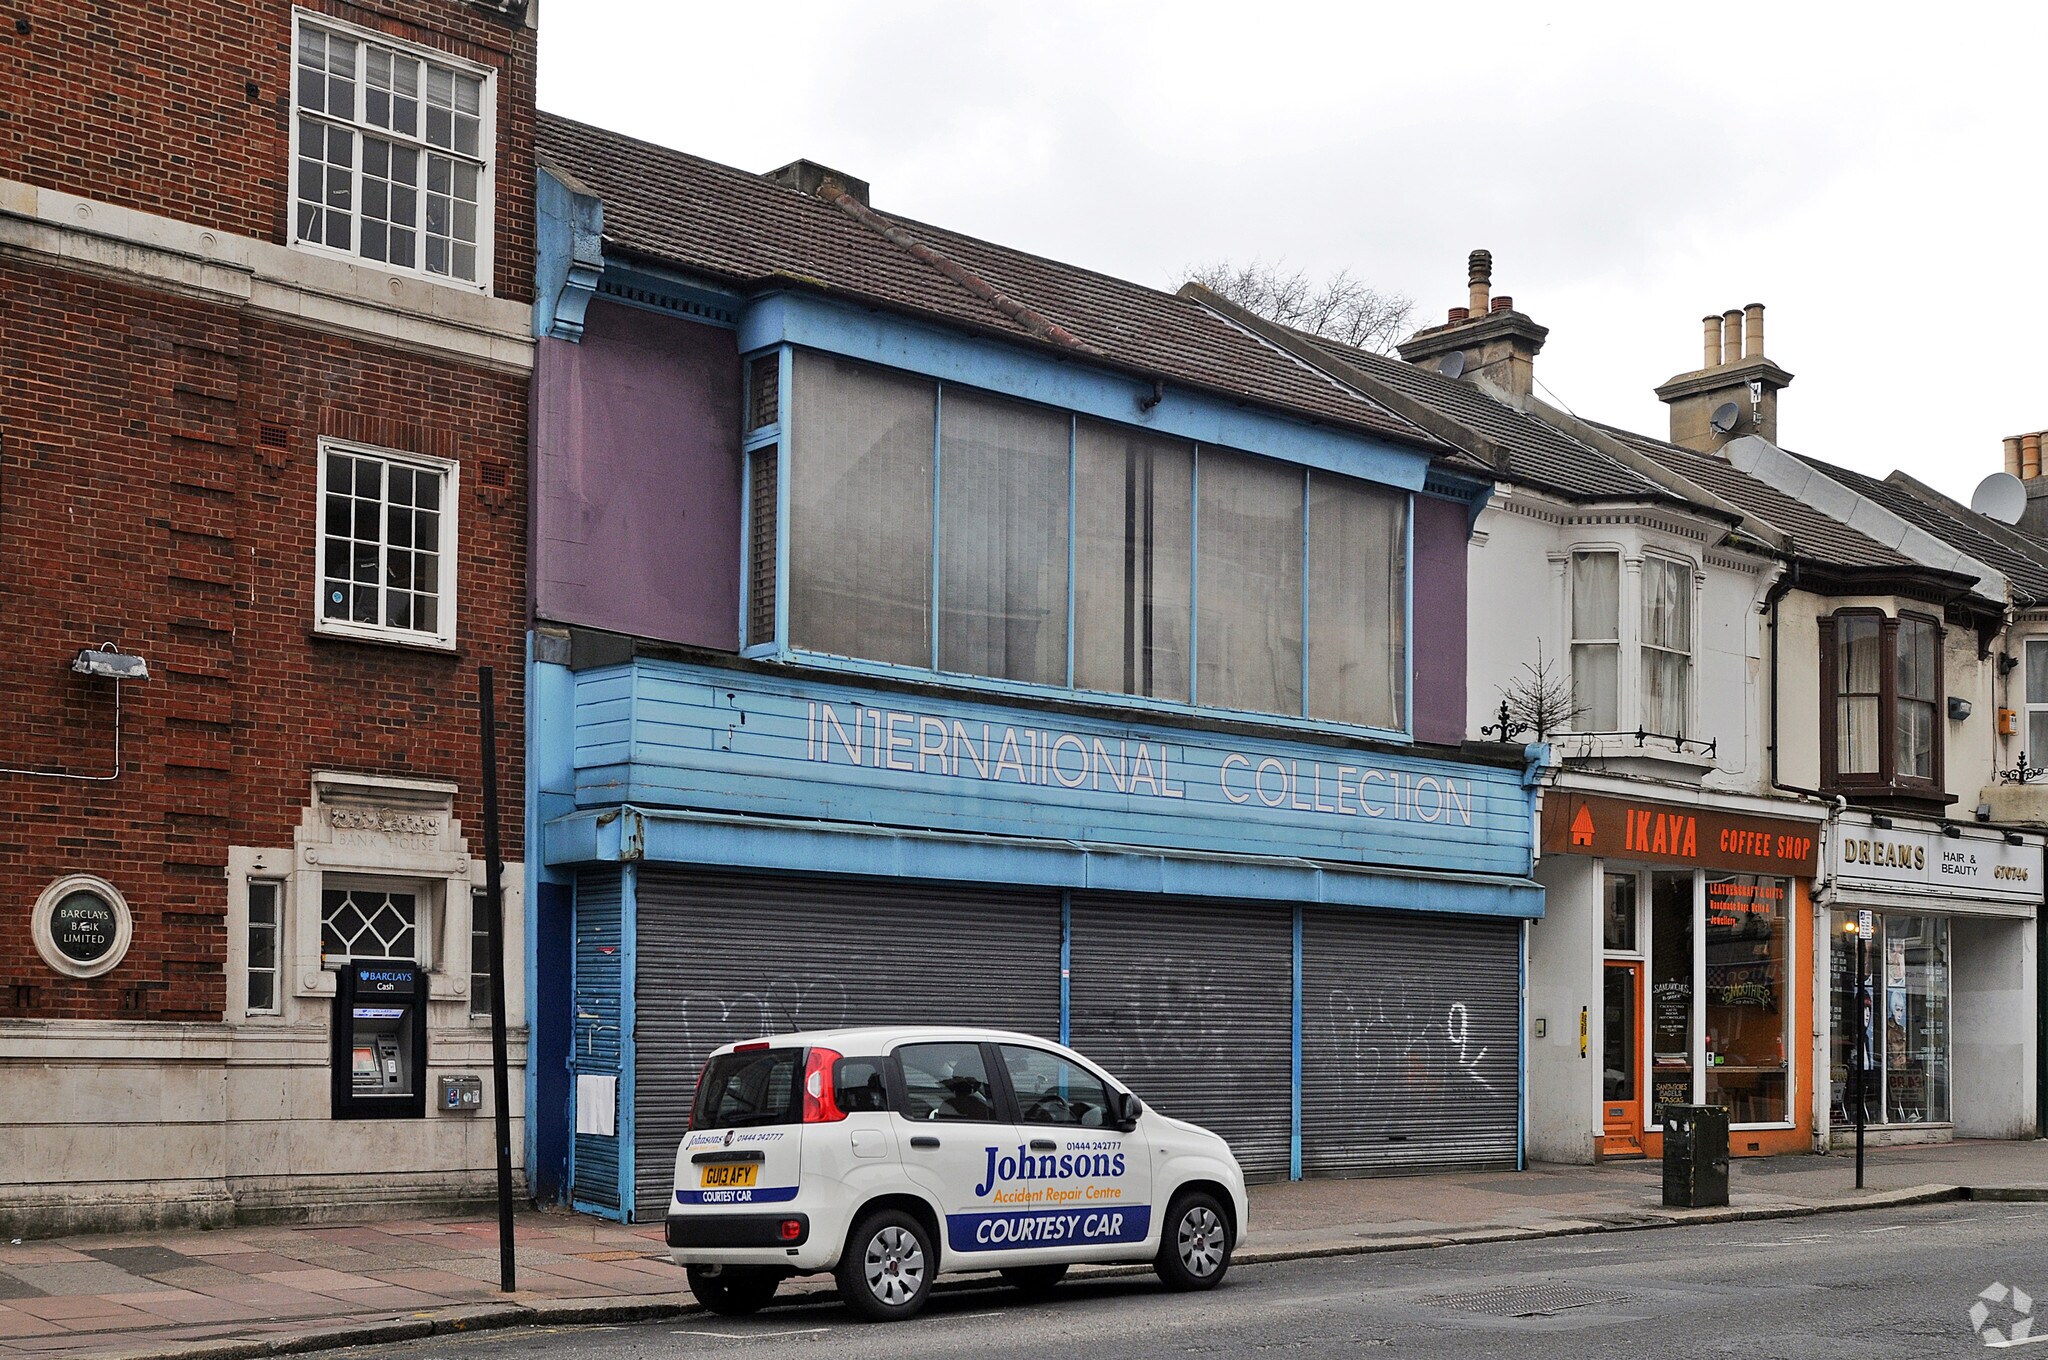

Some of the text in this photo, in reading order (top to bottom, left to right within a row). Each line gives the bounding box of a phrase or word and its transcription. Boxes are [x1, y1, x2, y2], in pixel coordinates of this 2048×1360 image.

[808, 702, 1471, 827] INTERNATIONAL COLLECTION
[339, 833, 434, 851] BANK HOUSE
[1625, 809, 1811, 860] IKAYA COFFEE SHOP
[1844, 838, 1925, 870] DREAMS
[1943, 852, 1976, 863] HAIR &
[1941, 864, 1978, 876] BEAUTY
[1994, 865, 2028, 881] 670746
[1710, 882, 1759, 898] LEATHERCRAFT
[1766, 887, 1784, 900] GIFTS
[60, 910, 108, 920] BARCLAYS
[72, 922, 98, 932] BNK
[64, 934, 104, 944] LIMITED
[370, 972, 412, 981] BARCLAYS
[1723, 982, 1770, 1004] SMOOTHIES
[686, 1134, 723, 1150] Johnsons
[737, 1134, 756, 1142] 01444
[756, 1133, 784, 1141] 242777
[1067, 1141, 1121, 1150] 01444 242777
[707, 1166, 752, 1184] GU13 AFY
[975, 1144, 1125, 1197] Johnsons
[703, 1190, 752, 1202] COURTESY CAR
[993, 1185, 1121, 1205] Accident Repair Centre
[976, 1213, 1124, 1244] COURTESY CAR
